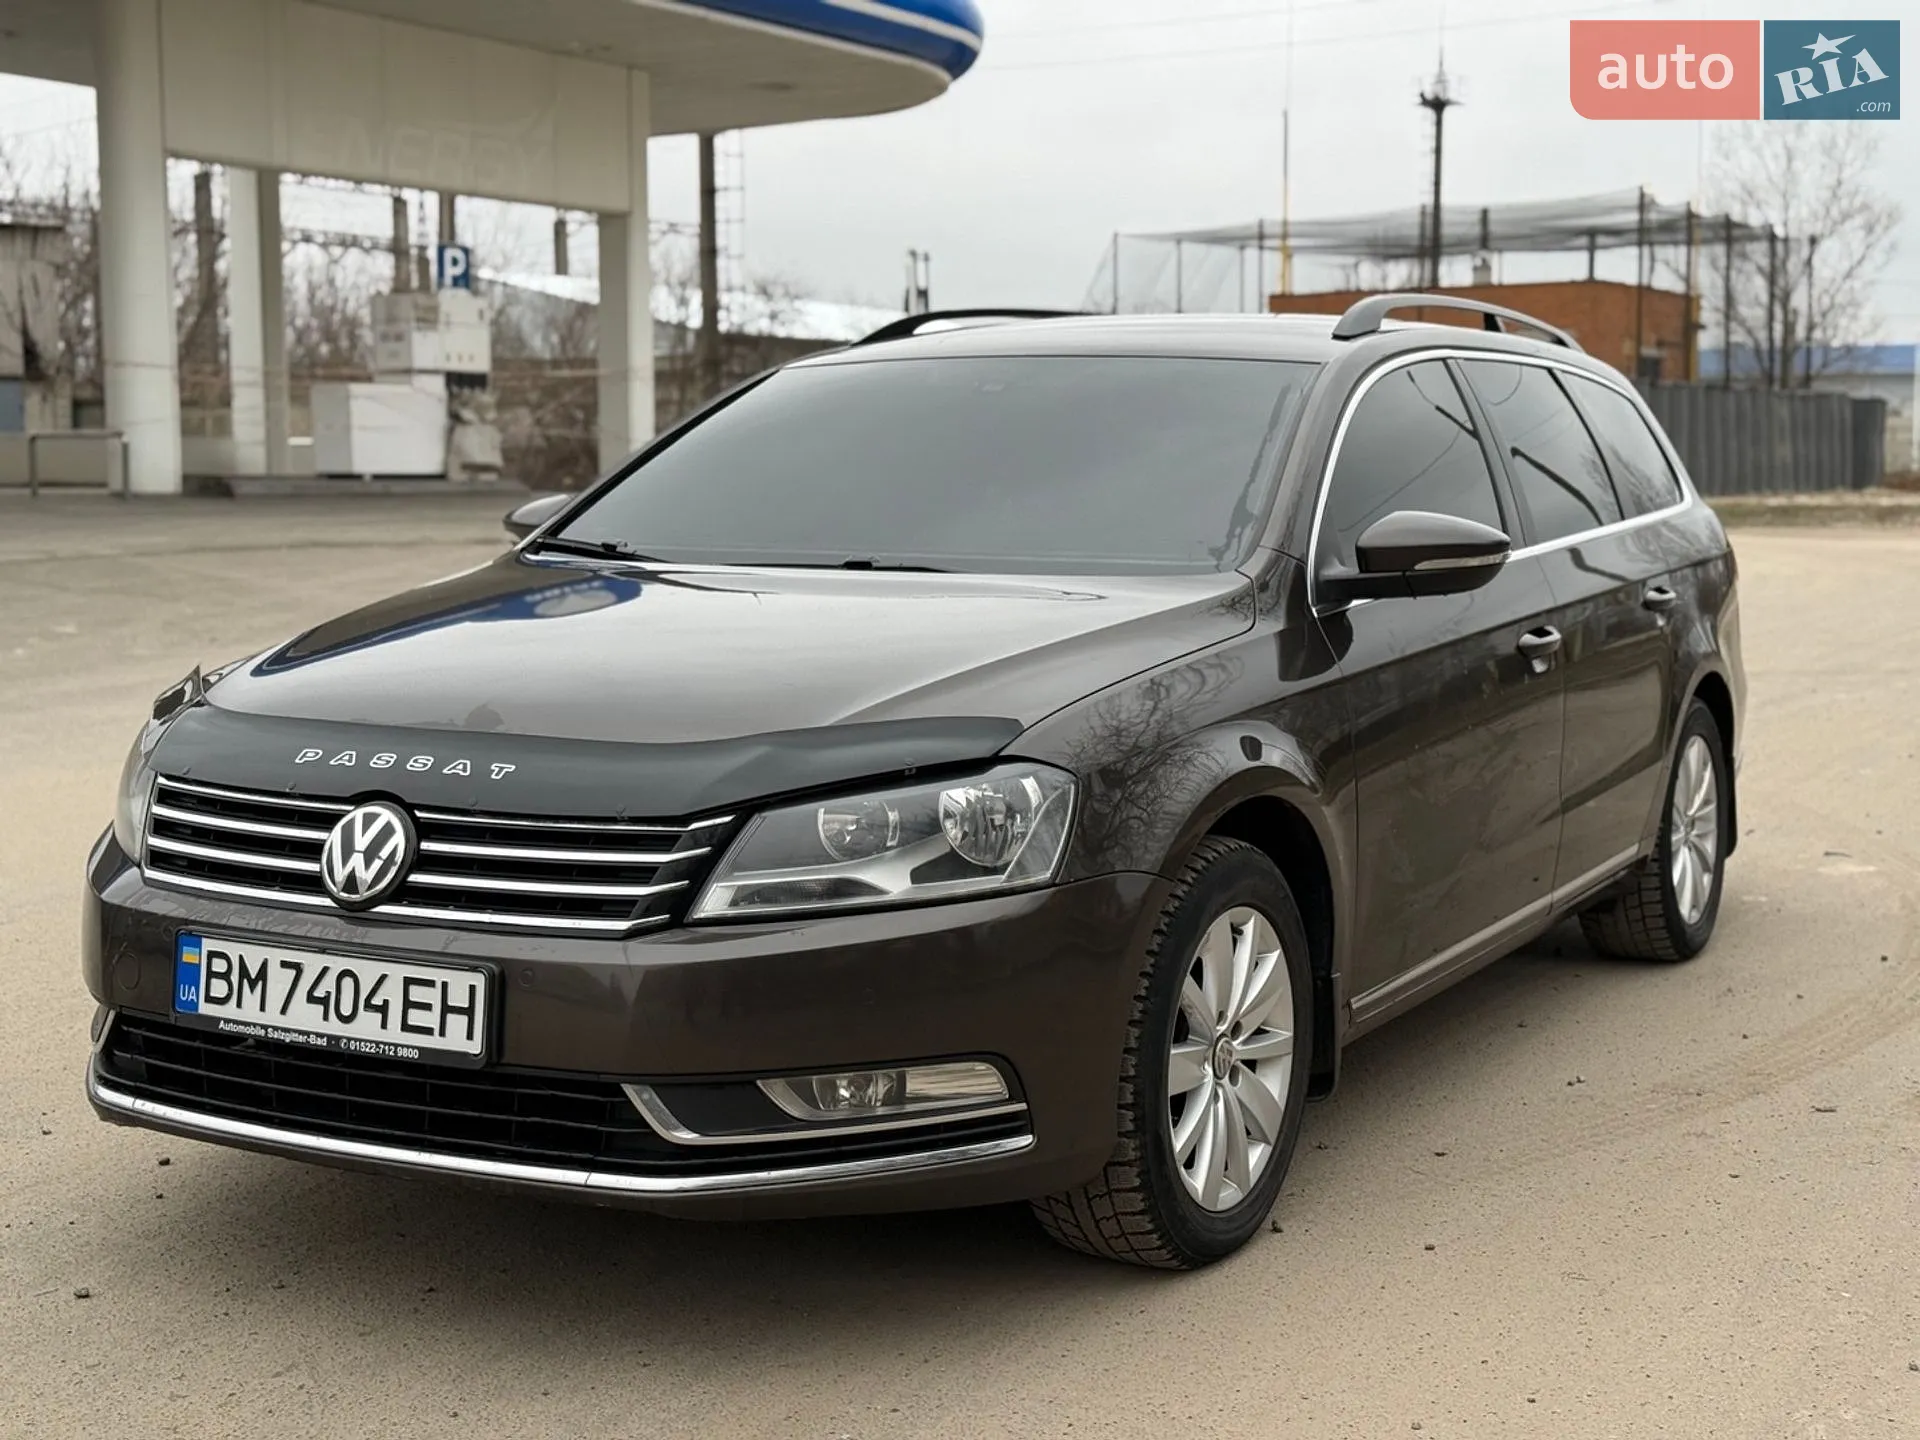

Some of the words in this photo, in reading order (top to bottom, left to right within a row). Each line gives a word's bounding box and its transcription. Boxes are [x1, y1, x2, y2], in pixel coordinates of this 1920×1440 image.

[443, 246, 468, 288] P
[295, 748, 516, 780] PASSAT
[180, 983, 197, 1003] UA
[219, 1020, 266, 1037] Automobile
[396, 1047, 419, 1059] 9800
